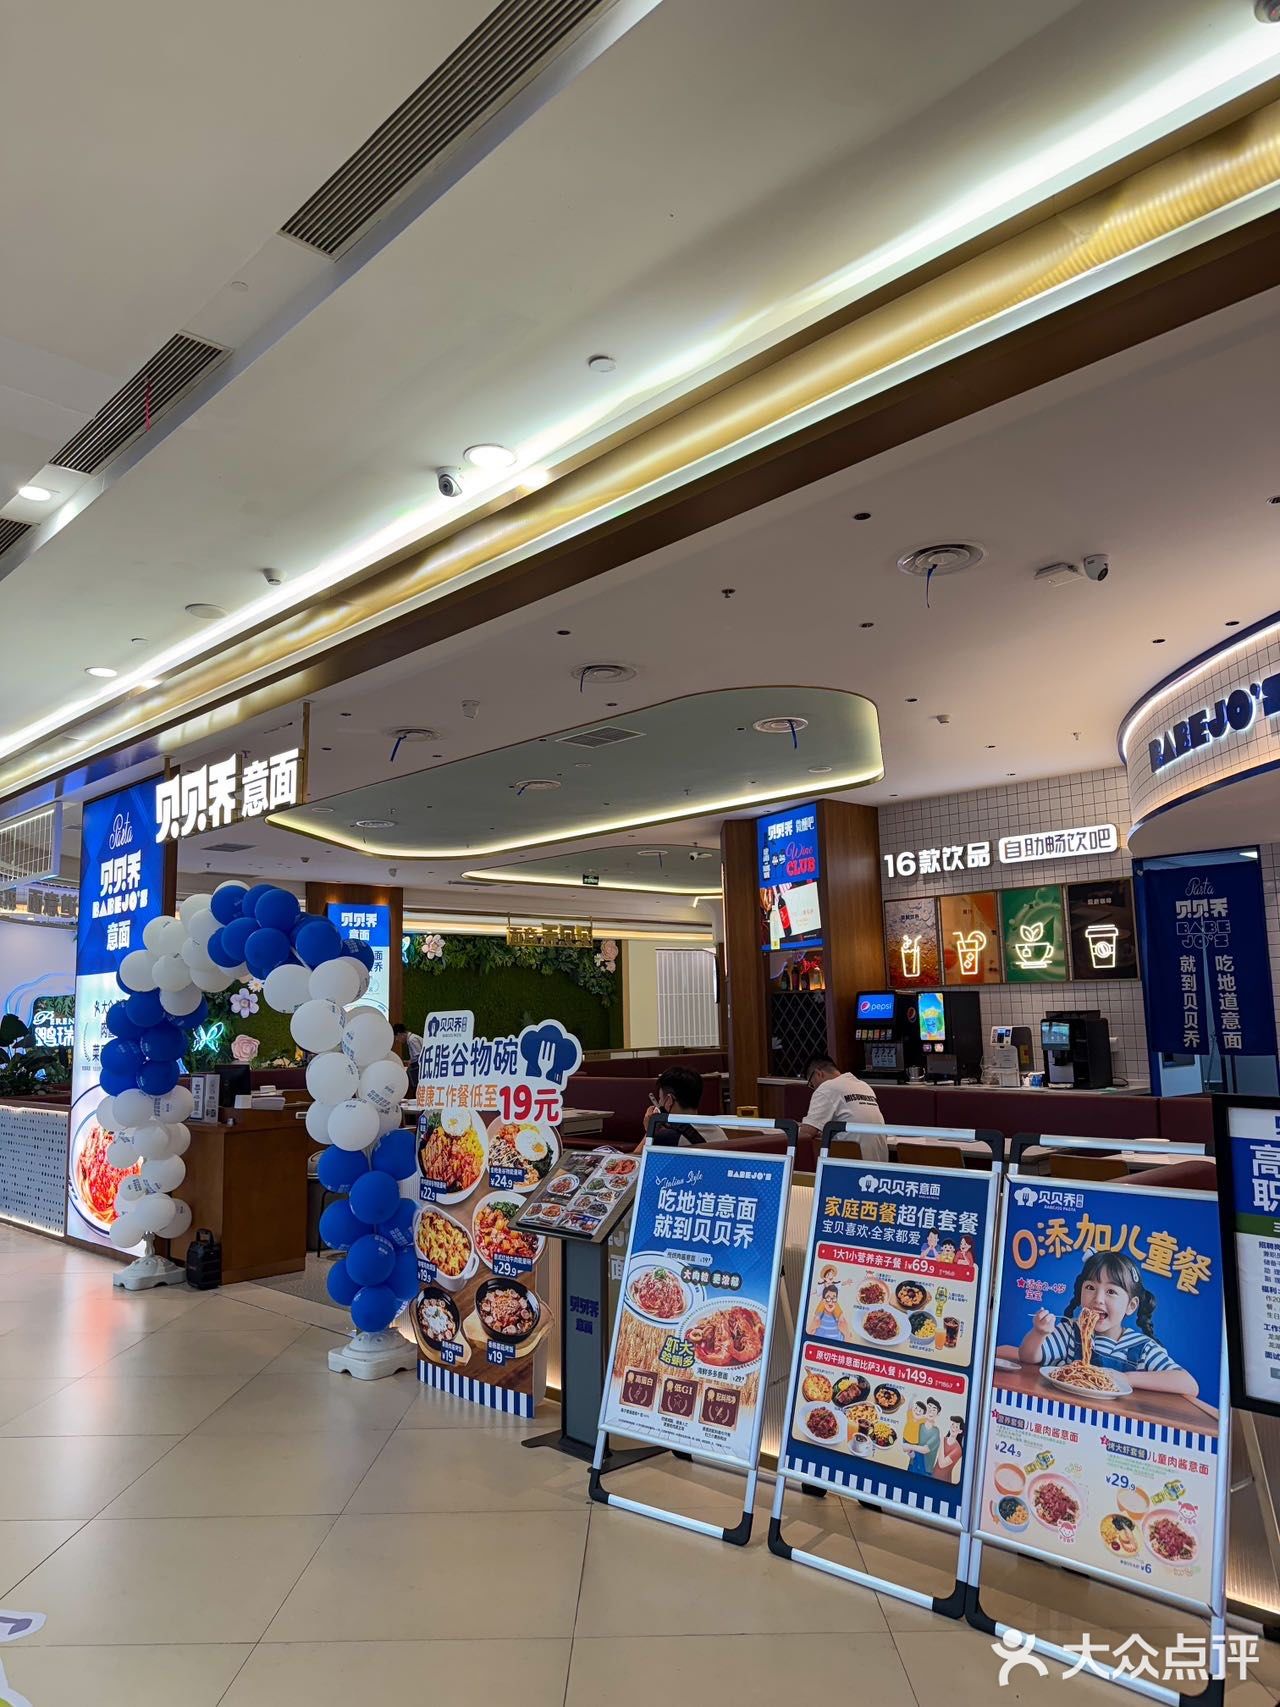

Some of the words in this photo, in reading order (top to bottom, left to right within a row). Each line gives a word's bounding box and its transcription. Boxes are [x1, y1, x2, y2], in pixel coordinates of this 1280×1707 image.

[156, 748, 299, 843] 贝贝乔意面
[109, 813, 133, 850] Pasta
[1005, 829, 1110, 859] 自助畅饮吧
[786, 857, 816, 877] CLUB
[883, 841, 990, 877] 16款饮品
[100, 850, 141, 897] 贝贝乔
[1185, 877, 1214, 896] Pasta
[1176, 897, 1228, 919] 贝贝乔
[341, 912, 377, 928] 贝贝乔
[1176, 920, 1230, 934] BABE
[106, 920, 131, 951] 意面
[871, 1003, 892, 1011] pepsi
[1179, 955, 1200, 1048] 就到贝贝乔
[1215, 955, 1242, 1049] 吃地道意面
[440, 1017, 462, 1032] 贝贝乔
[419, 1039, 518, 1080] 低脂谷物碗
[416, 1084, 498, 1108] 健康工作餐低至
[500, 1085, 559, 1122] 19元
[491, 1175, 513, 1188] ¥24.9
[879, 1178, 941, 1198] 贝贝乔意面
[421, 1186, 436, 1201] ¥22.9
[1038, 1190, 1076, 1207] 贝贝乔
[657, 1188, 758, 1223] 吃地道意面
[824, 1196, 979, 1236] 家庭西餐超值套餐
[653, 1213, 754, 1249] 就到贝贝乔
[833, 1249, 902, 1270] 1大1小营养亲子餐
[1013, 1213, 1213, 1295] 0添加儿童餐
[494, 1262, 517, 1276] ¥29.9
[488, 1350, 503, 1363] ¥19
[674, 1383, 693, 1395] 低GI
[1025, 1420, 1079, 1444] 儿童肉酱意面
[995, 1441, 1021, 1458] ¥24.9
[1147, 1450, 1209, 1476] 儿童肉酱意面
[1105, 1473, 1136, 1491] ¥29.9
